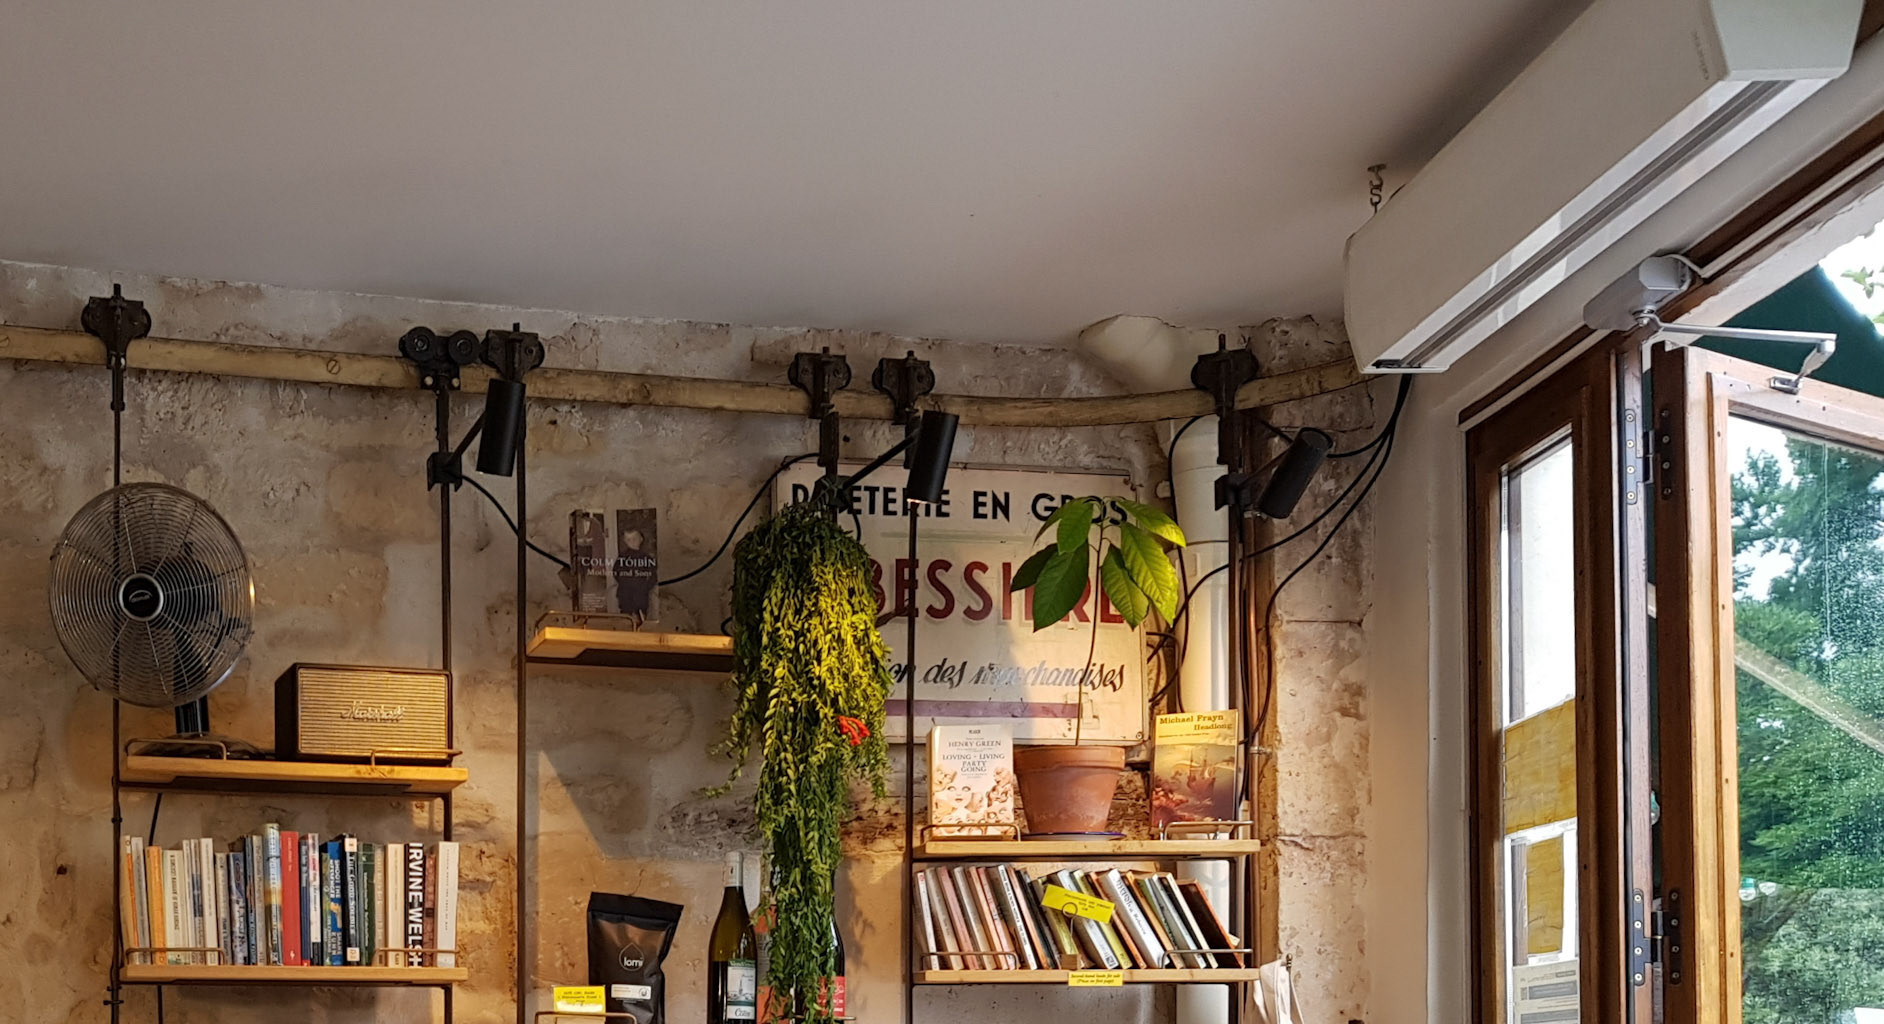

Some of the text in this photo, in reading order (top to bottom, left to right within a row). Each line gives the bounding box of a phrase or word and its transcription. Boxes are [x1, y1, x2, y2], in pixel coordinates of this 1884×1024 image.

[972, 490, 1011, 523] EN
[581, 556, 614, 567] COLM
[620, 569, 632, 577] and
[634, 569, 652, 577] Sons
[918, 658, 968, 689] des
[968, 660, 1126, 693] marchandises
[339, 700, 407, 722] Marshall
[1159, 713, 1224, 725] Michael Frayn
[1193, 722, 1234, 731] Headlong
[408, 842, 424, 968] IRVINE WELSH
[623, 956, 644, 967] lomi
